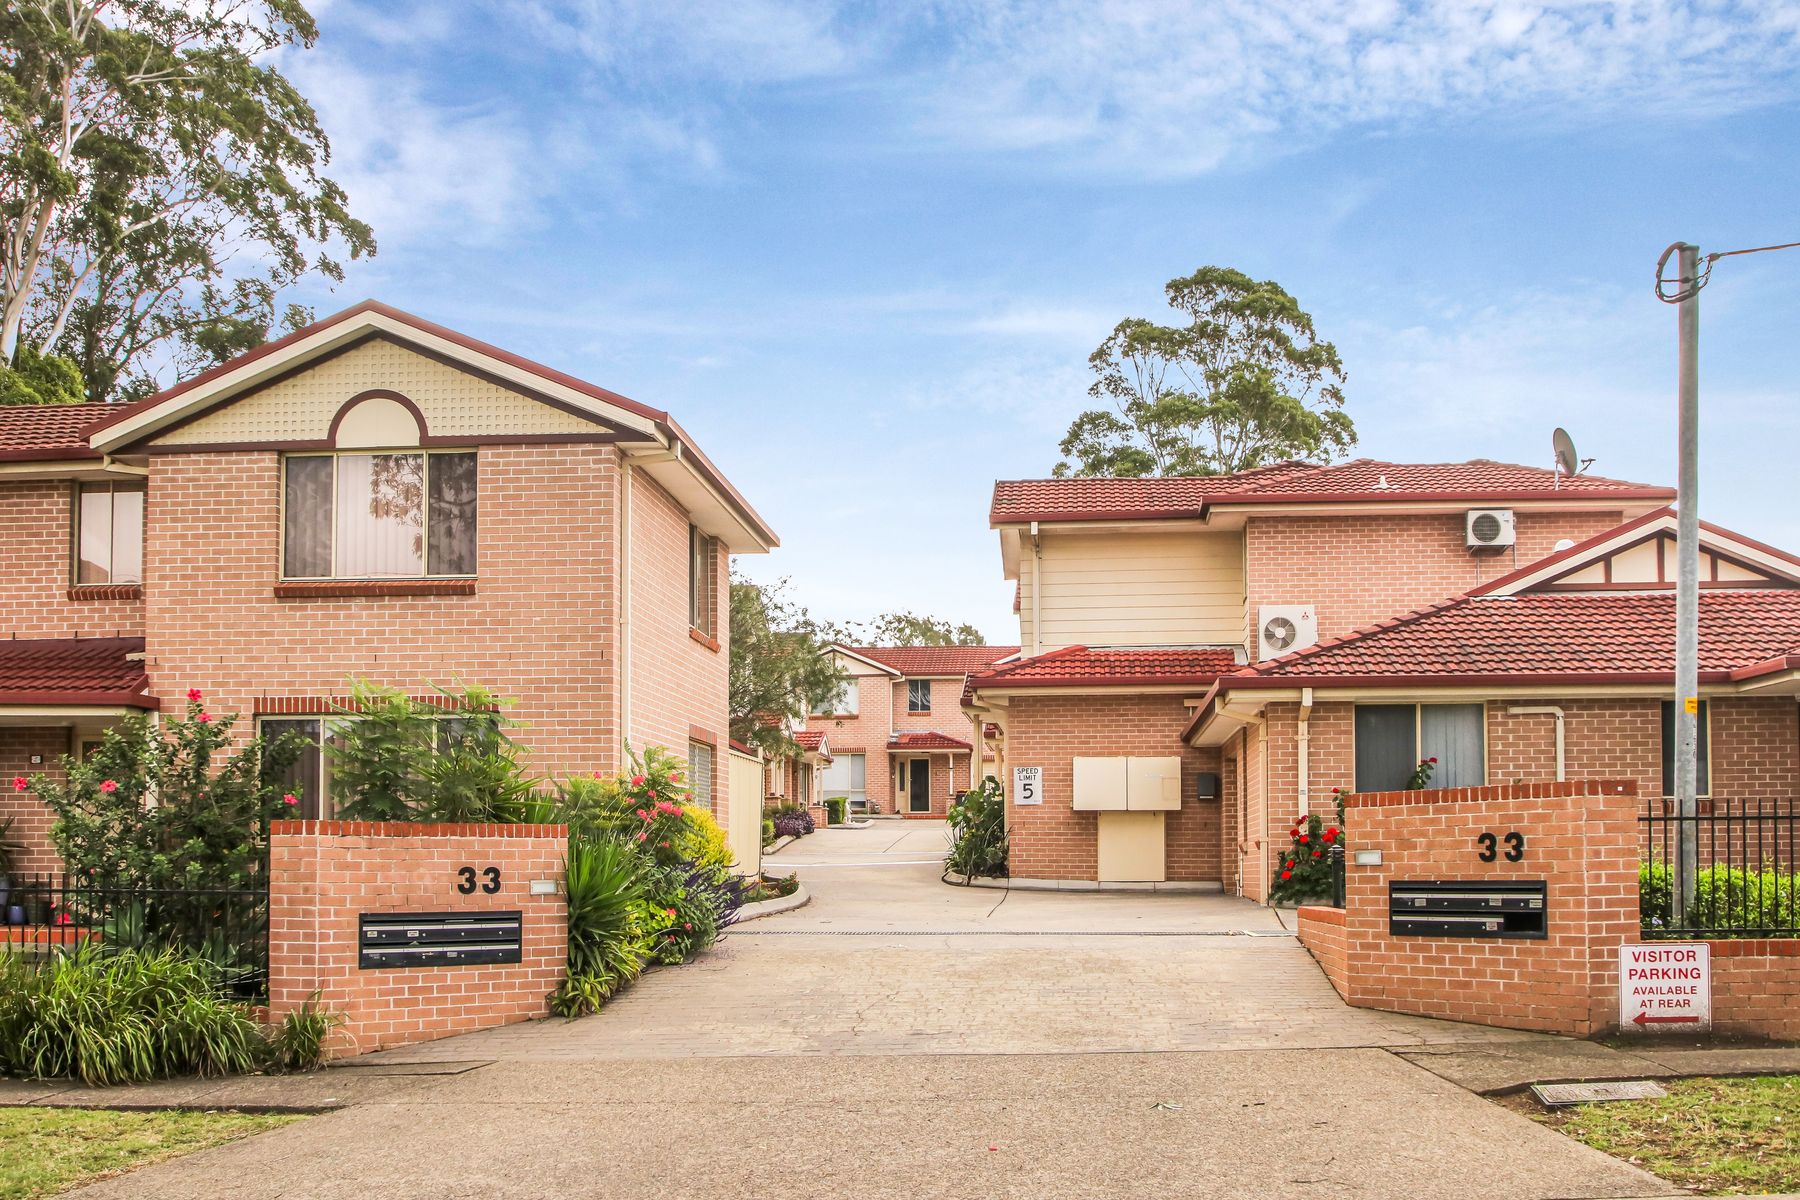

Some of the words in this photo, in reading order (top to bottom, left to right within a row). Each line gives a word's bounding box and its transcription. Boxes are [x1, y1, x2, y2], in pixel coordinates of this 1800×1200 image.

[1017, 767, 1039, 775] SPEED
[1022, 783, 1034, 799] 5
[1477, 831, 1524, 863] 33
[457, 866, 501, 895] 33
[1632, 950, 1697, 963] VISITOR
[1628, 967, 1701, 980] PARKING
[1632, 985, 1698, 996] AVAILABLE
[1639, 999, 1654, 1009] AT
[1658, 998, 1691, 1008] REAR
